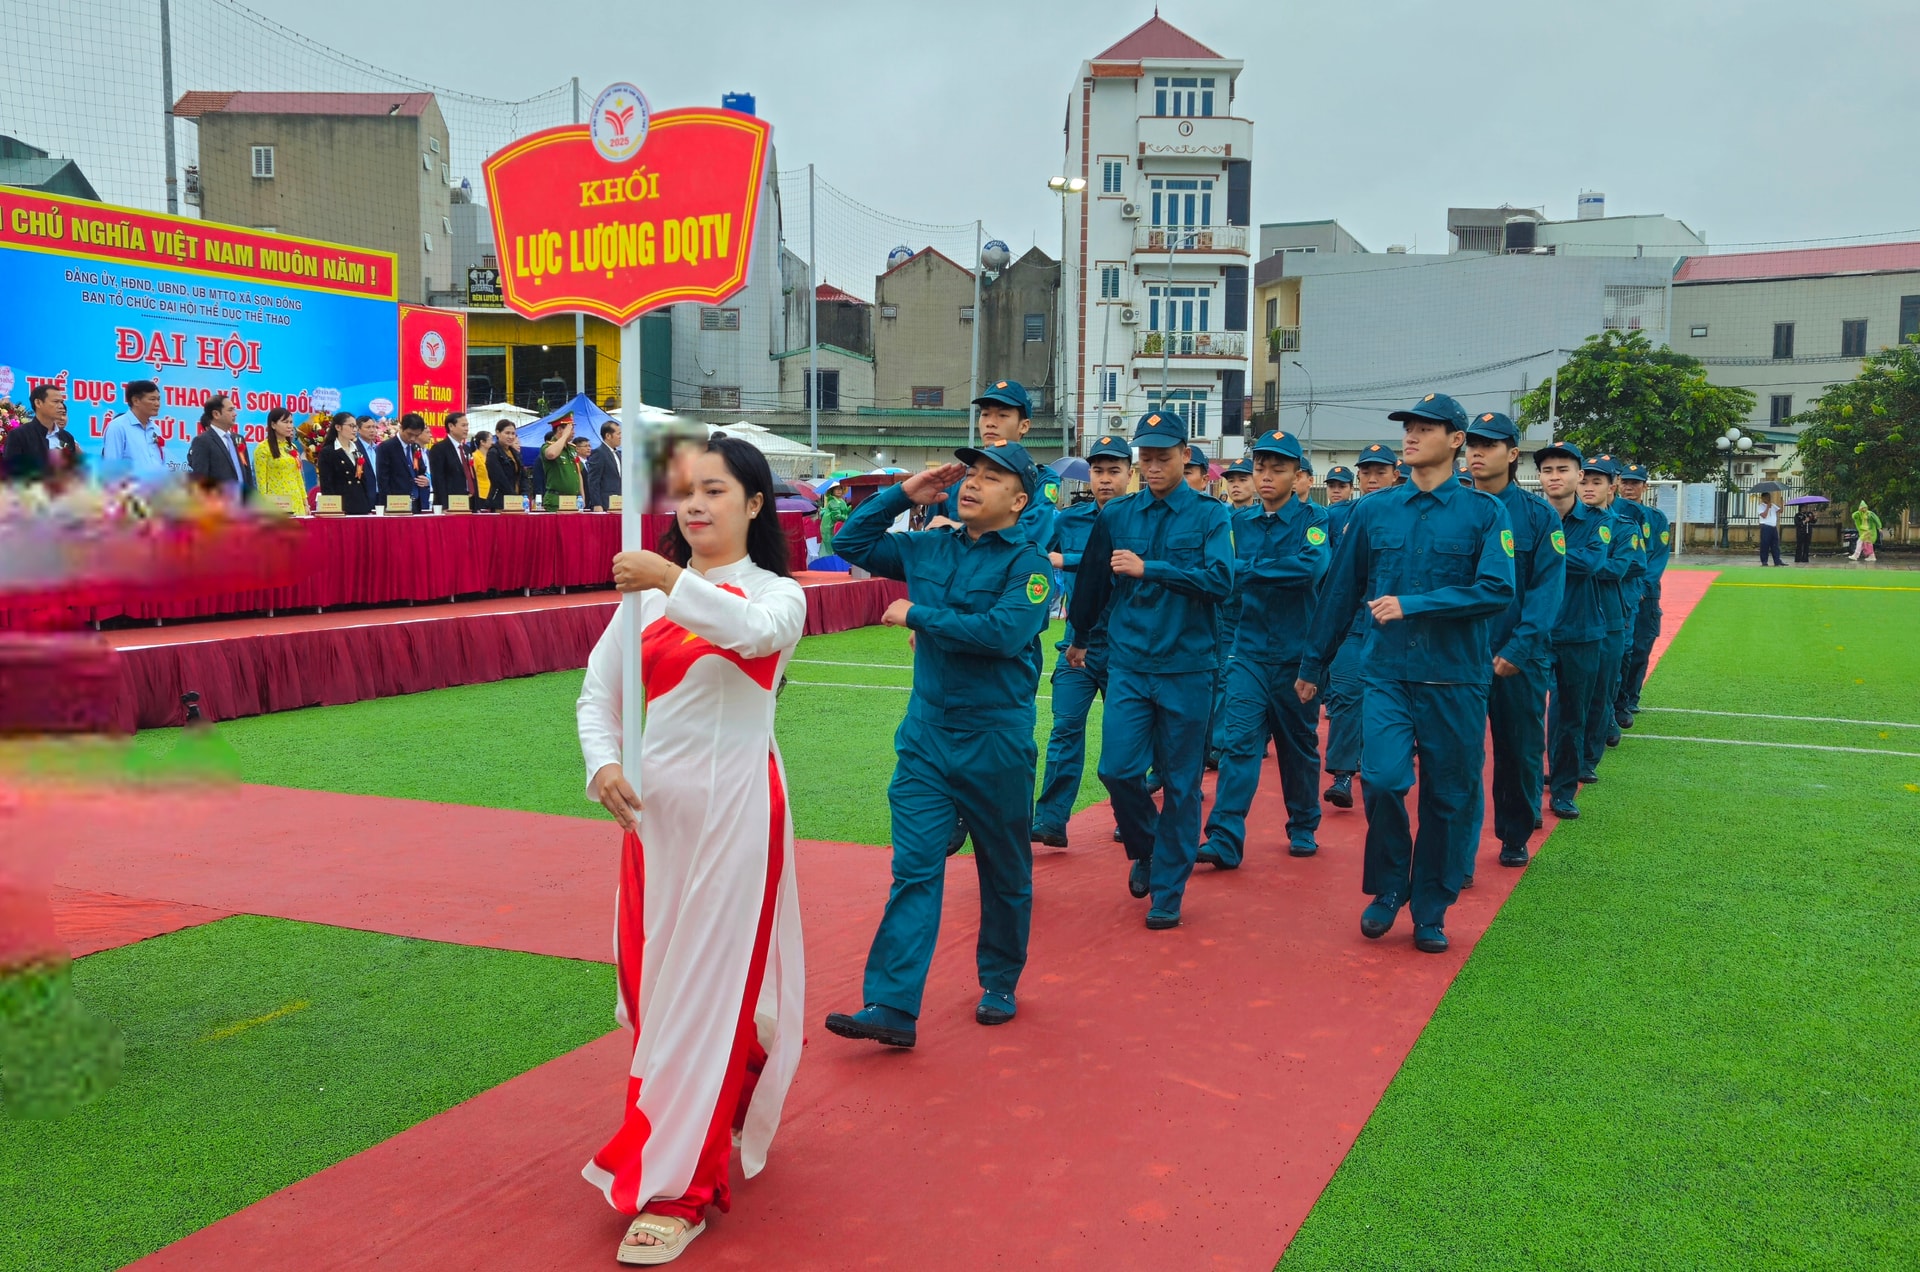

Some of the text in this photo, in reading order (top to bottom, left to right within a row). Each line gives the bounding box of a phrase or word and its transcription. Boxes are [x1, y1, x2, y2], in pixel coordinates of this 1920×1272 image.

[609, 136, 630, 148] 2025
[579, 165, 660, 207] KHỐI
[11, 206, 377, 286] CHỦ NGHĨA VIỆT NAM MUÔN NĂM !
[516, 213, 732, 286] LỰC LƯỢNG DQTV
[65, 267, 98, 284] ĐẢNG
[101, 270, 118, 288] ỦY,
[121, 277, 155, 292] HĐND,
[192, 286, 206, 298] UB
[209, 289, 237, 302] MTTQ
[239, 291, 252, 304] XÃ
[254, 294, 273, 307] SƠN
[82, 289, 291, 326] BAN TỔ CHỨC ĐẠI HỘI THỂ DỤC THỂ THAO
[115, 327, 261, 376] ĐẠI HỘI
[74, 379, 116, 406] DỤC
[163, 386, 211, 407] THAO
[246, 391, 282, 411] SƠN
[286, 389, 331, 415] ĐỒ
[413, 380, 452, 402] THỂ THAO
